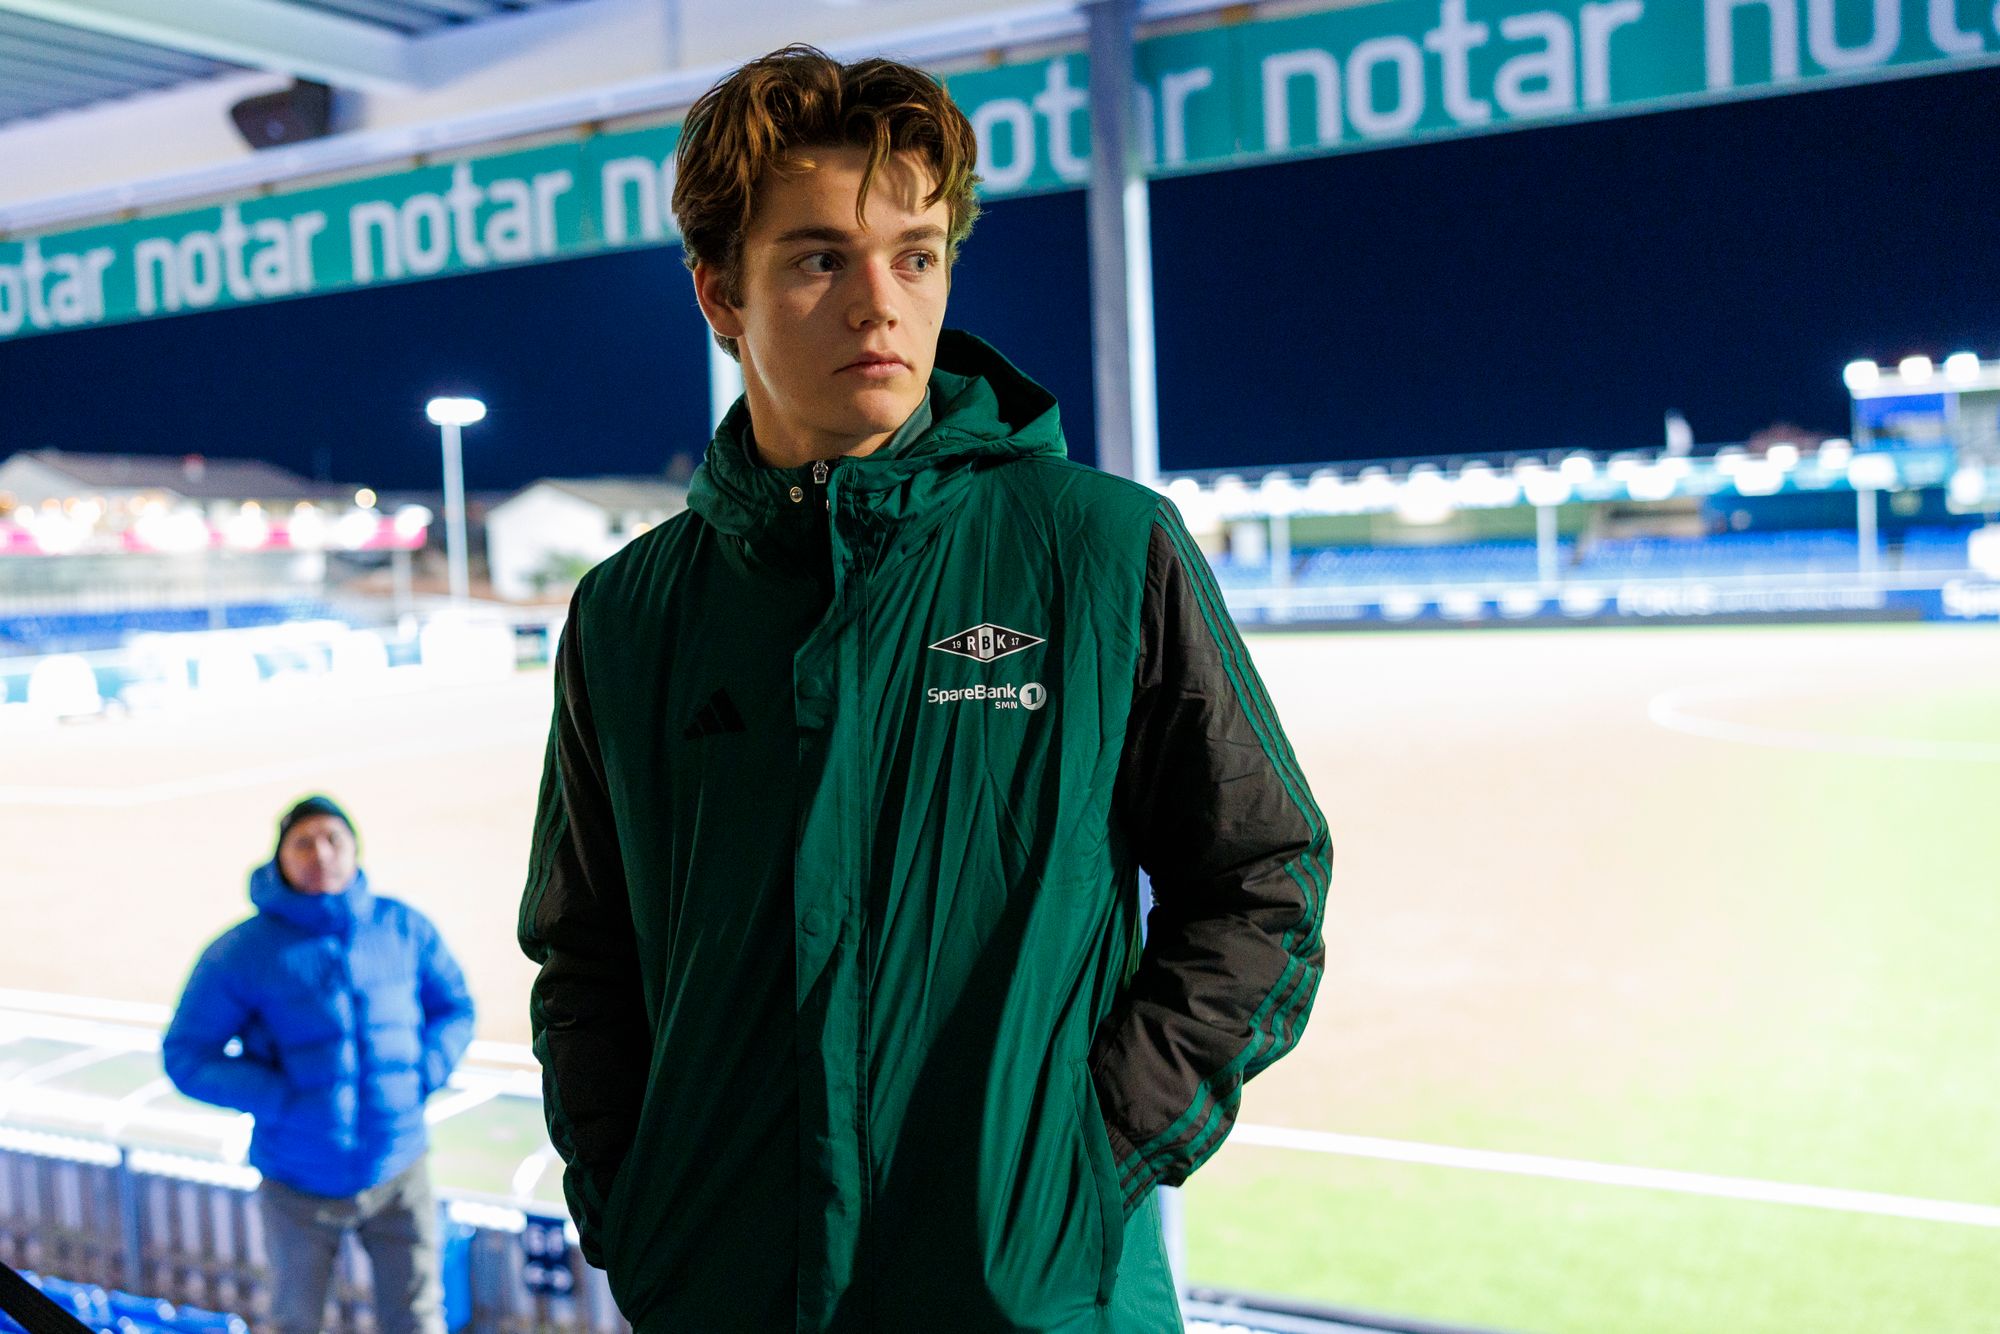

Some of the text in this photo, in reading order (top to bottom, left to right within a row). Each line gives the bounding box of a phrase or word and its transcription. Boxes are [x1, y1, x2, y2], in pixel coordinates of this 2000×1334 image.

[0, 237, 116, 336] otar
[134, 204, 328, 315] notar
[349, 160, 573, 284] notar
[970, 57, 1214, 192] otr
[1262, 0, 1645, 152] notar
[1704, 0, 2000, 90] no
[952, 634, 1020, 650] 19 RBK 17
[927, 683, 1016, 704] SpareBank
[995, 701, 1017, 709] SMN
